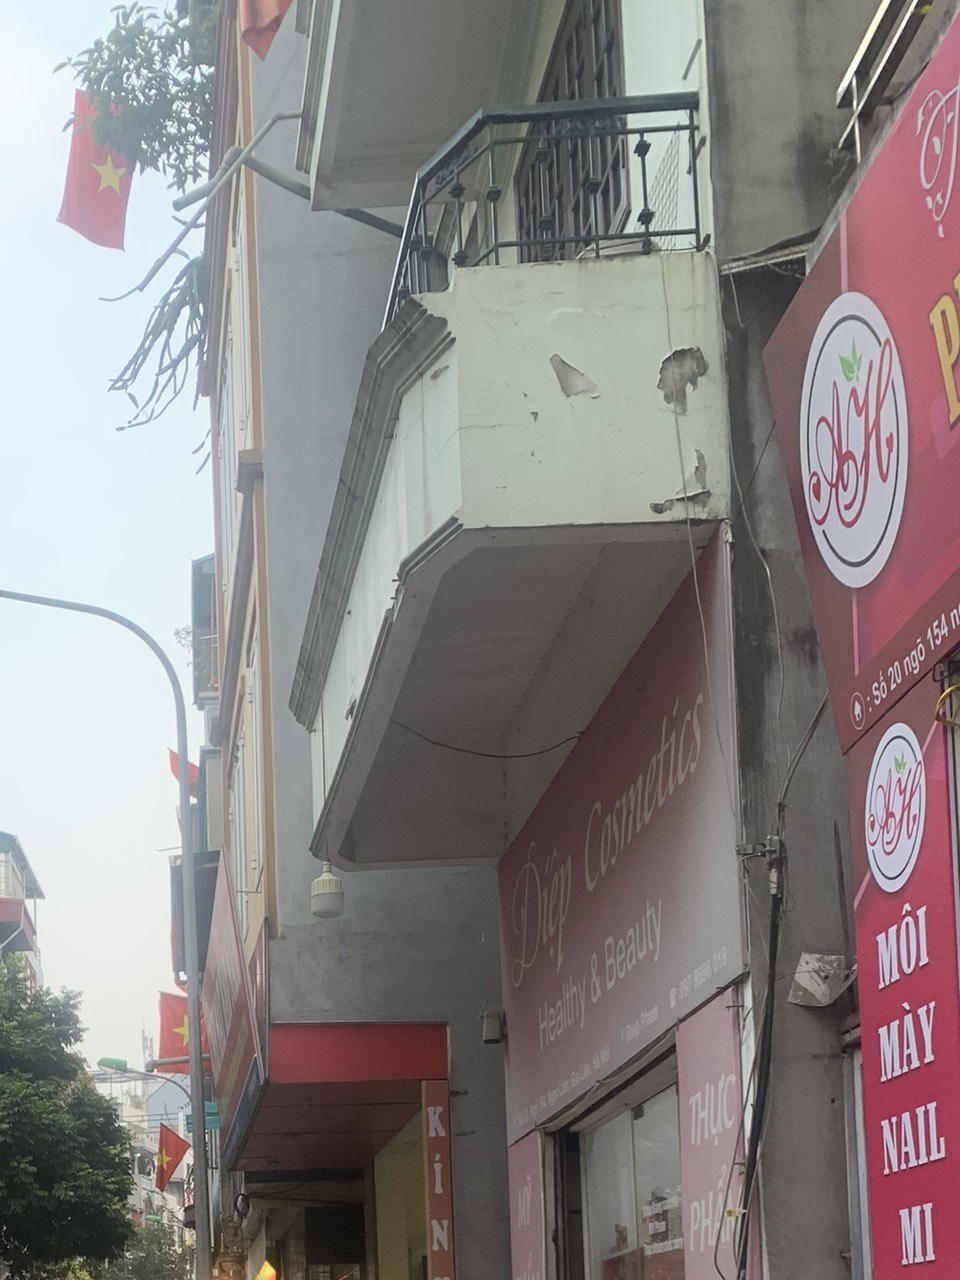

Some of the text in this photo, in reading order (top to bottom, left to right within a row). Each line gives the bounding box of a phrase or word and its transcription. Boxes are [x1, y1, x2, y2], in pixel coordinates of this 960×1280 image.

[872, 670, 888, 705] Số
[888, 661, 902, 691] 20
[927, 613, 949, 650] 154
[584, 693, 703, 893] Cosmetics
[539, 898, 663, 1051] Healthy & Beauty
[876, 902, 929, 990] MÔI
[878, 1001, 936, 1083] MÀY
[689, 1071, 736, 1149] THỰC
[880, 1101, 946, 1176] NAIL
[898, 1202, 936, 1266] MI
